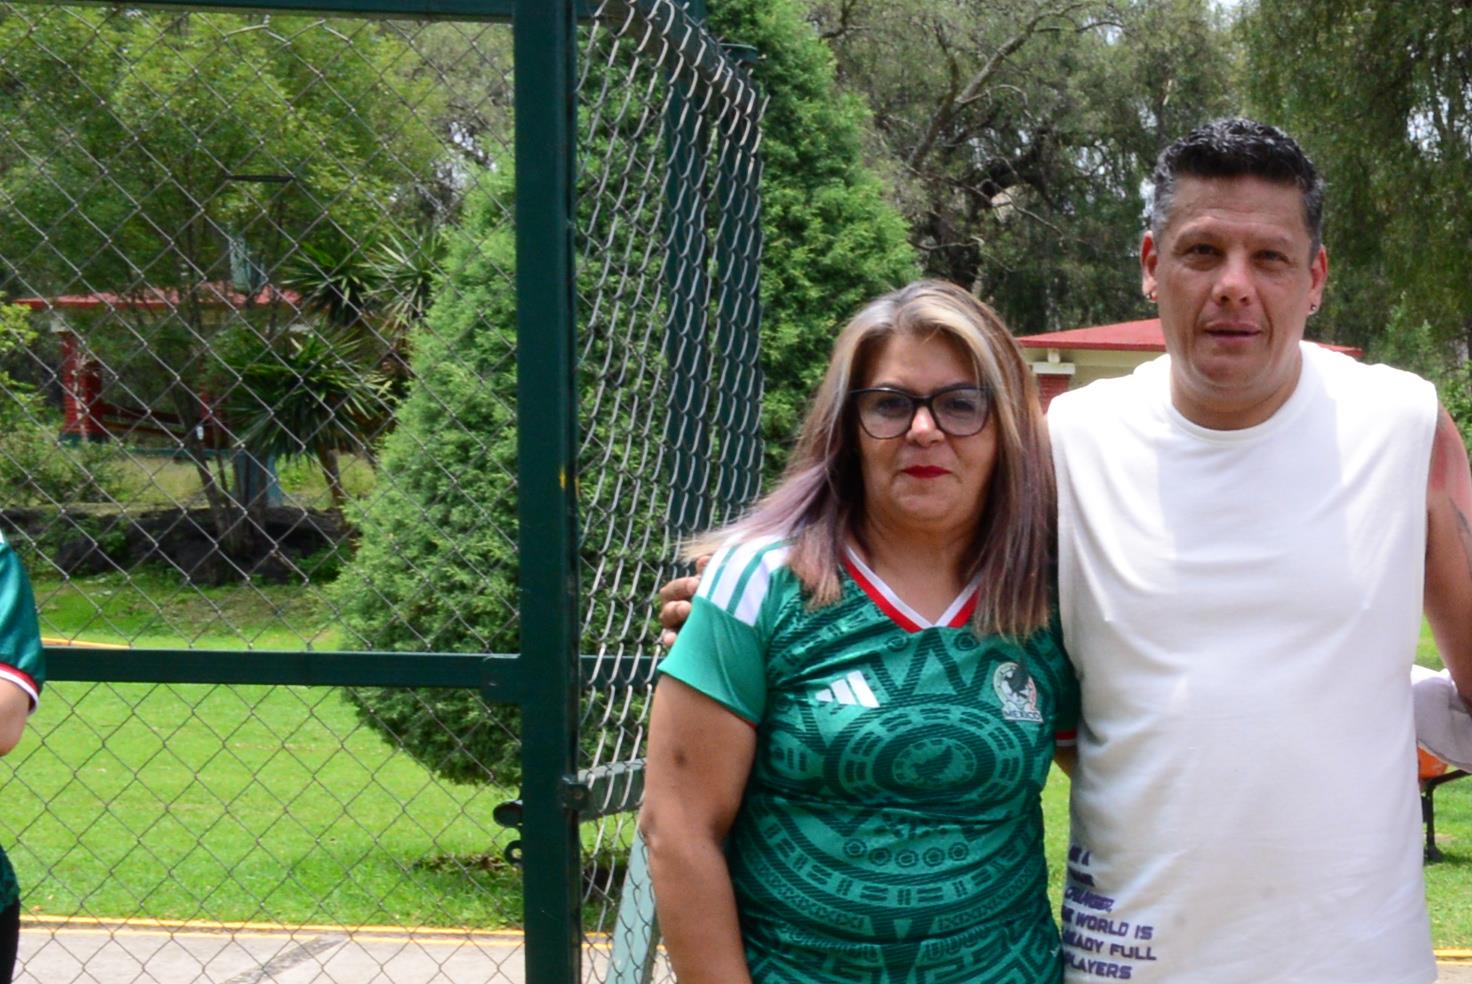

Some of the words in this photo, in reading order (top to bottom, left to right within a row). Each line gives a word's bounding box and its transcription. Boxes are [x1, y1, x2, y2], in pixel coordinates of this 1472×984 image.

[1075, 911, 1130, 937] WORLD
[1134, 924, 1155, 941] IS
[1110, 943, 1157, 961] FULL
